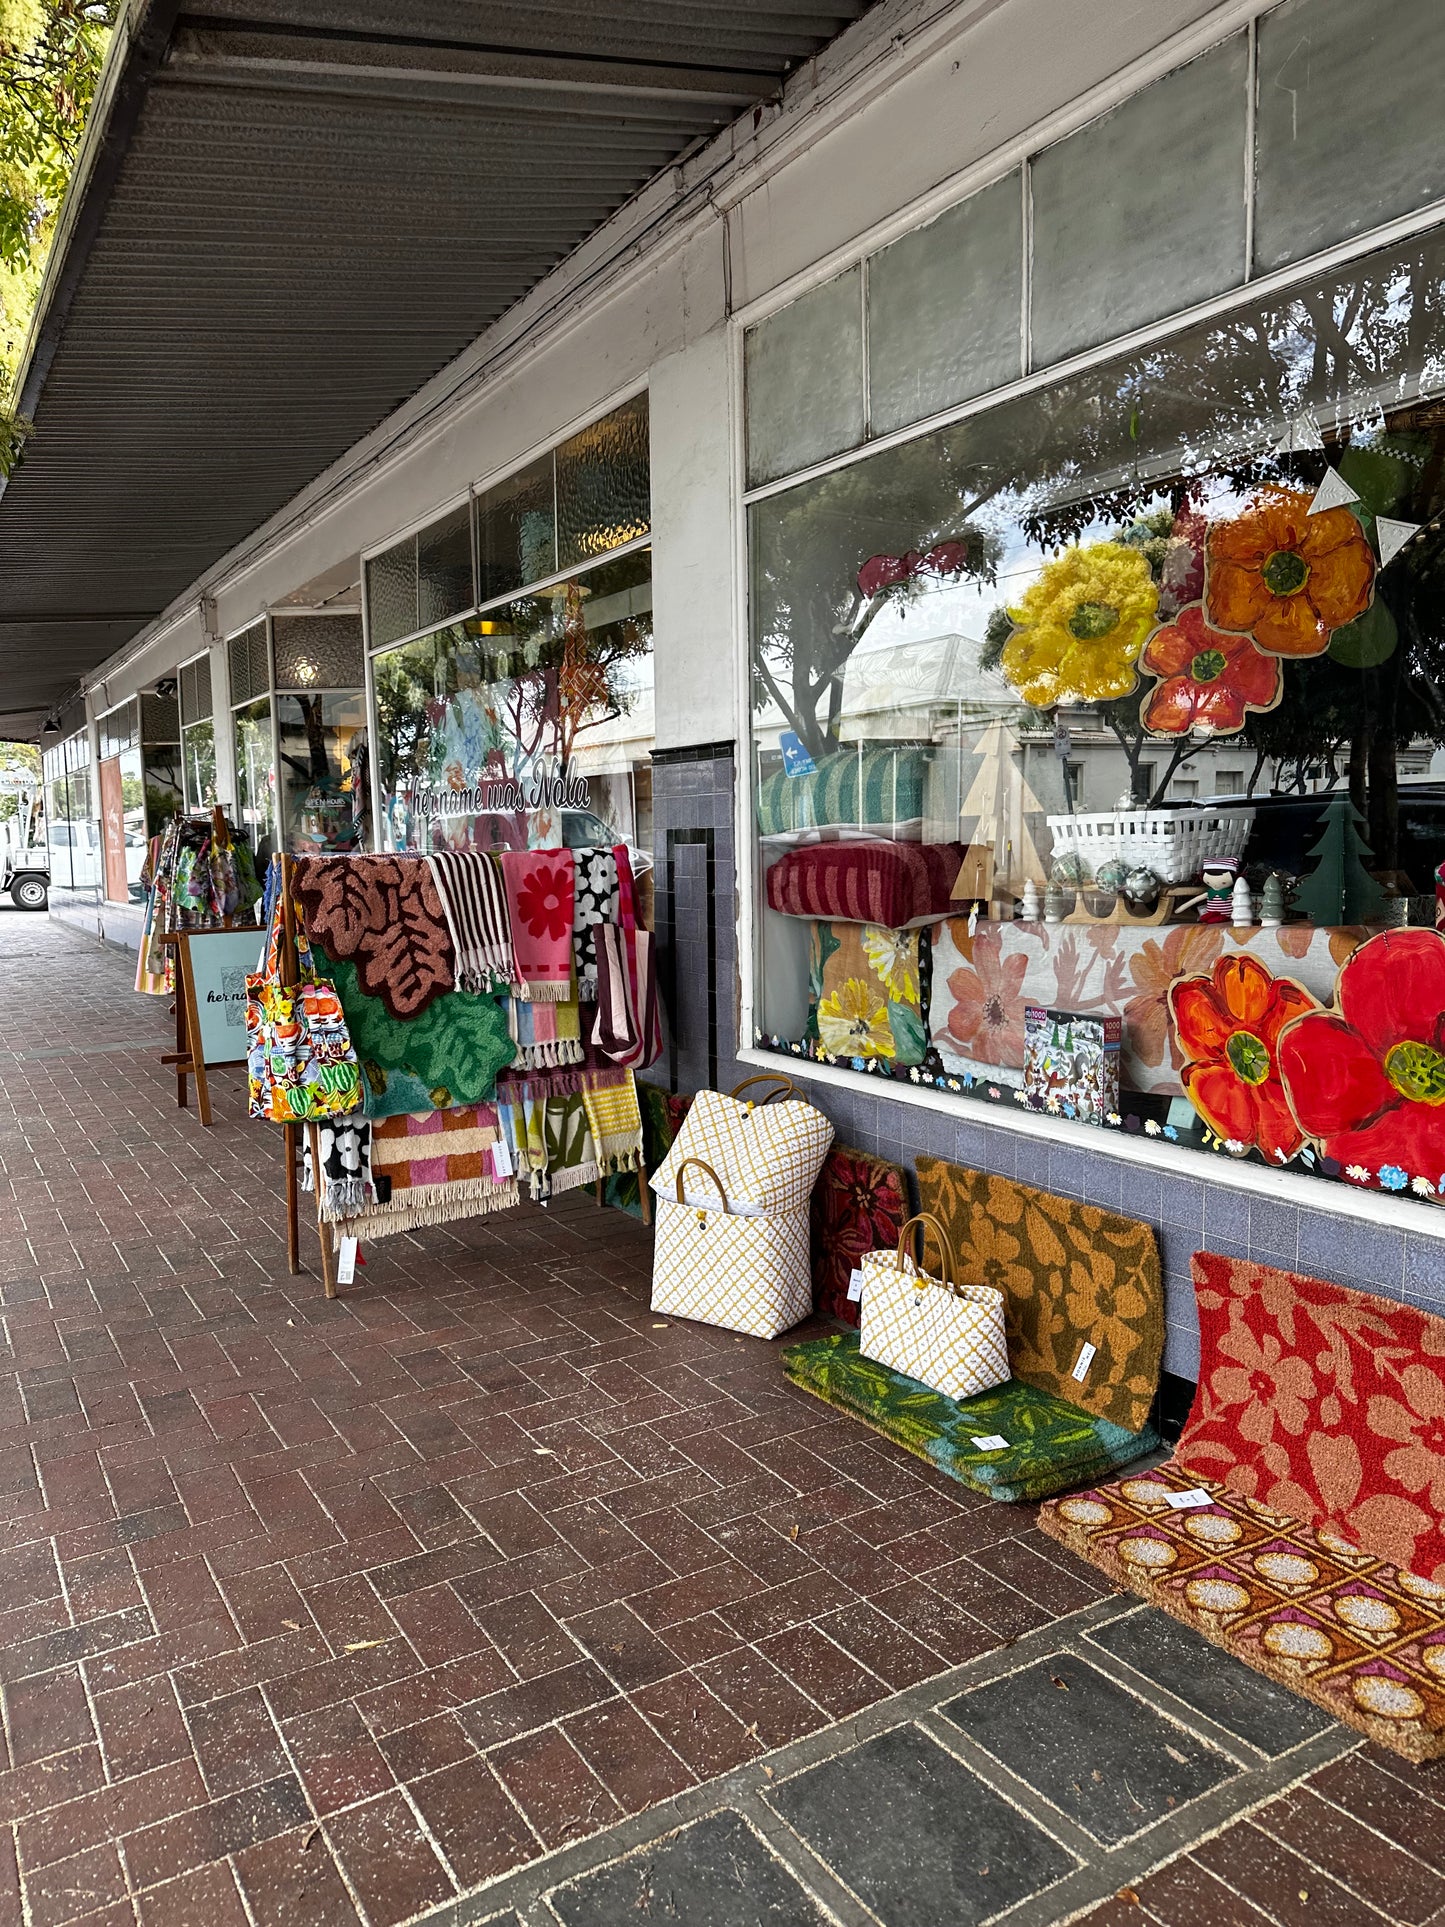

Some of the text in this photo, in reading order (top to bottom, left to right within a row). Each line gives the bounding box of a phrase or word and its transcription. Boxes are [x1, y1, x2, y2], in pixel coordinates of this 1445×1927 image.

[411, 755, 591, 818] her name was Nola
[207, 990, 230, 1003] her
[1031, 1010, 1046, 1020] 1000
[1105, 1021, 1120, 1030] 1000
